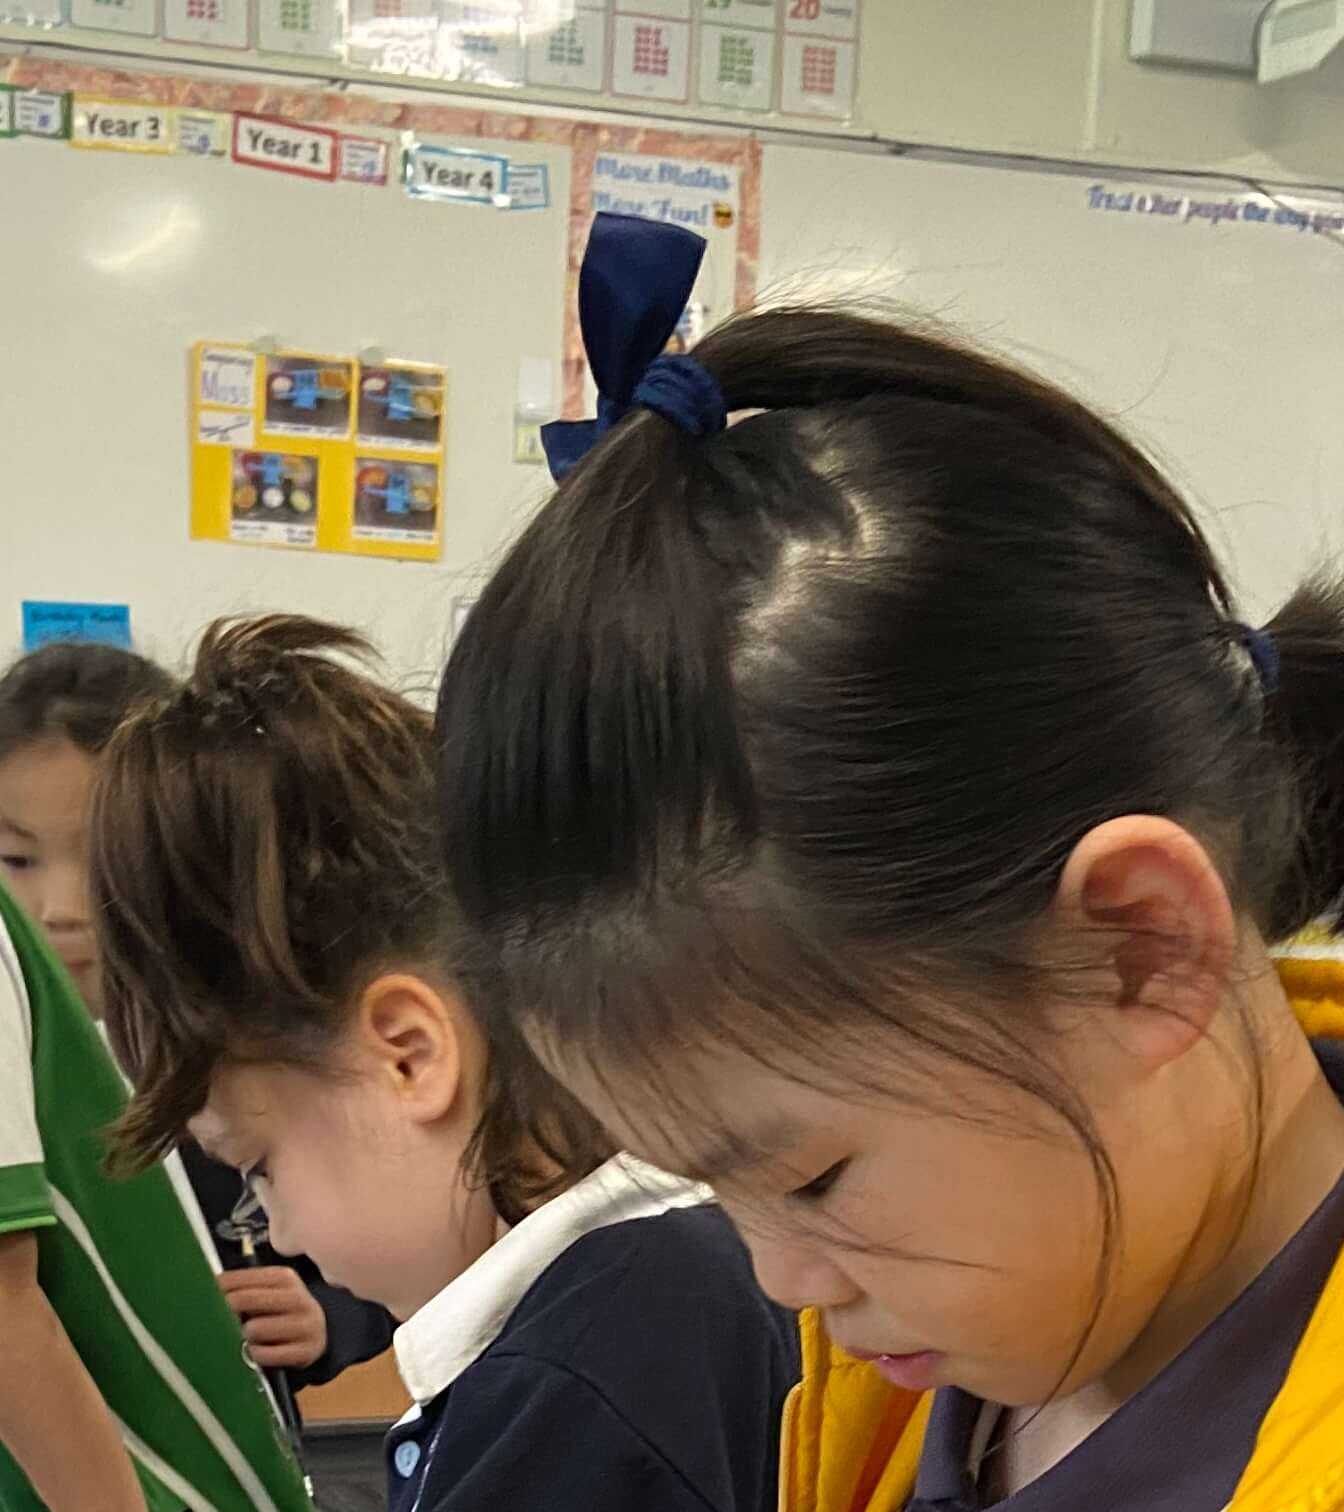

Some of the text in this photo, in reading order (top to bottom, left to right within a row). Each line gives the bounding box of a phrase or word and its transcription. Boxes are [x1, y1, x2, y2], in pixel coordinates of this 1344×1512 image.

[86, 111, 137, 138] Year
[145, 116, 160, 139] 3
[247, 129, 301, 162] Year
[309, 143, 323, 164] 1
[422, 161, 474, 188] Year
[478, 171, 494, 190] 4
[658, 162, 730, 191] Maths
